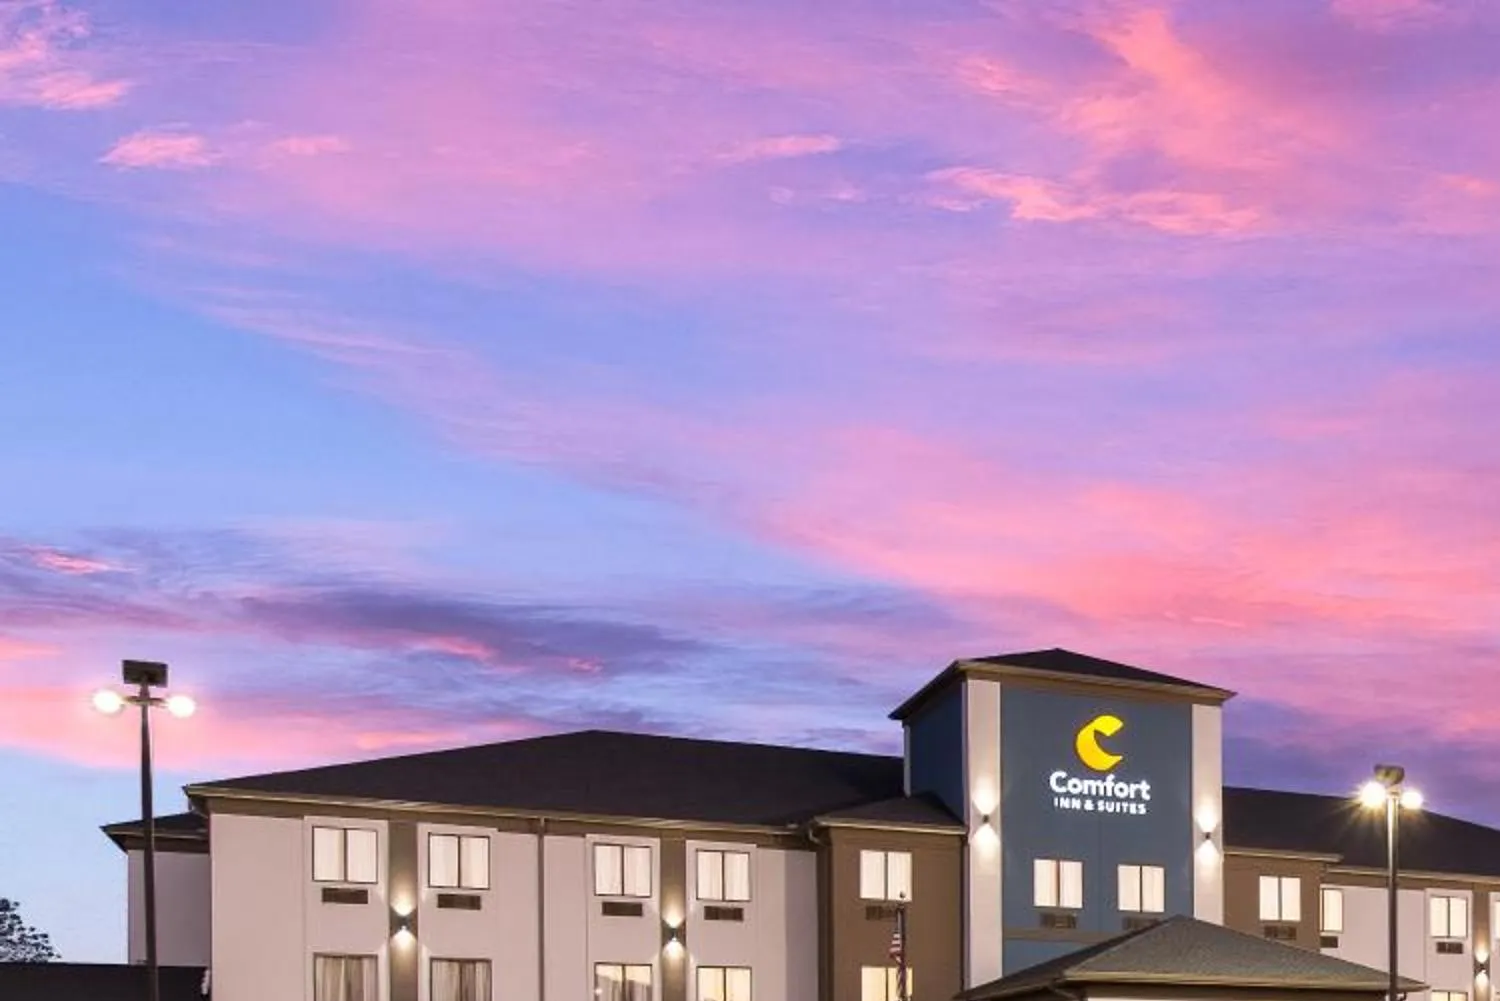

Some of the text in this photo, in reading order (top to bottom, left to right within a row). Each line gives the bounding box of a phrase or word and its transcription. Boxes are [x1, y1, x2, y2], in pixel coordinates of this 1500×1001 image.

[1050, 770, 1151, 801] Comfort
[1054, 797, 1147, 815] INN & SUITES
